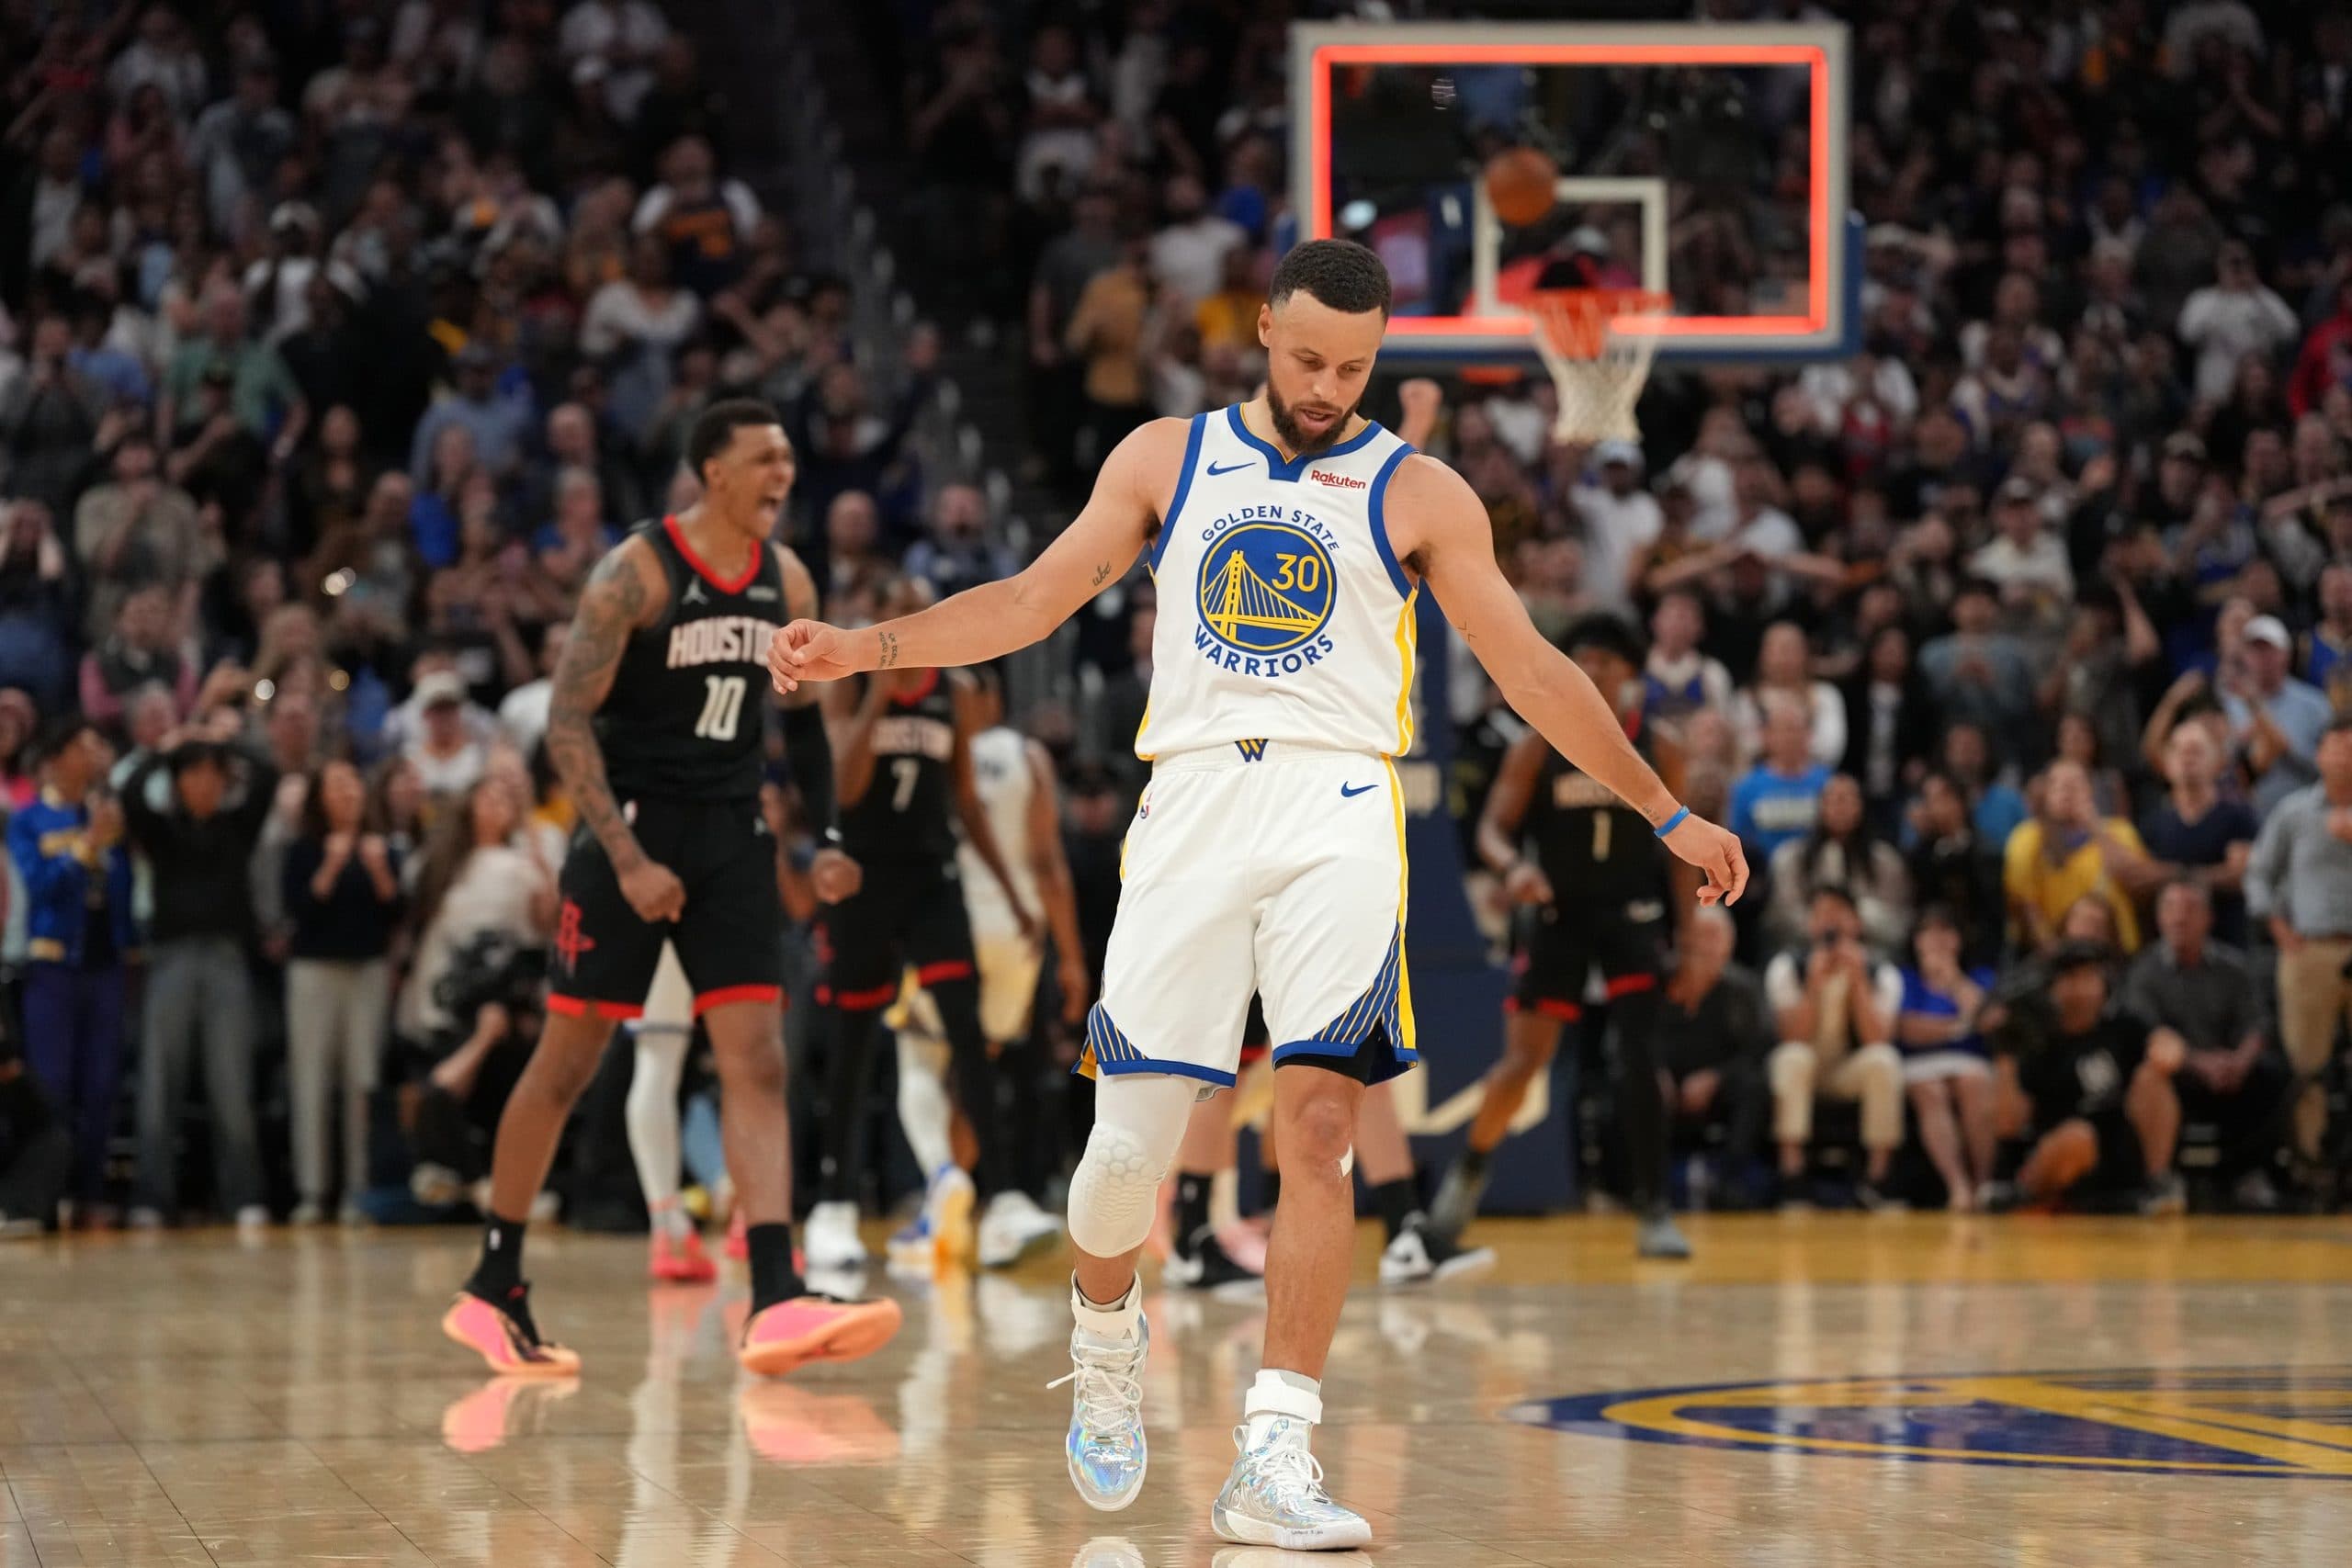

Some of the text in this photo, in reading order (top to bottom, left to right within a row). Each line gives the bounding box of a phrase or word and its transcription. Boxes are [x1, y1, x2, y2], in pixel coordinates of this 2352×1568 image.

[1311, 469, 1366, 490] Rakuten
[1202, 505, 1340, 551] GOLDEN STATE
[1272, 553, 1319, 592] 30
[666, 615, 780, 671] HOUSTO
[1194, 624, 1334, 678] WARRIORS
[695, 675, 747, 741] 10
[890, 756, 920, 812] 7
[1591, 807, 1612, 862] 1
